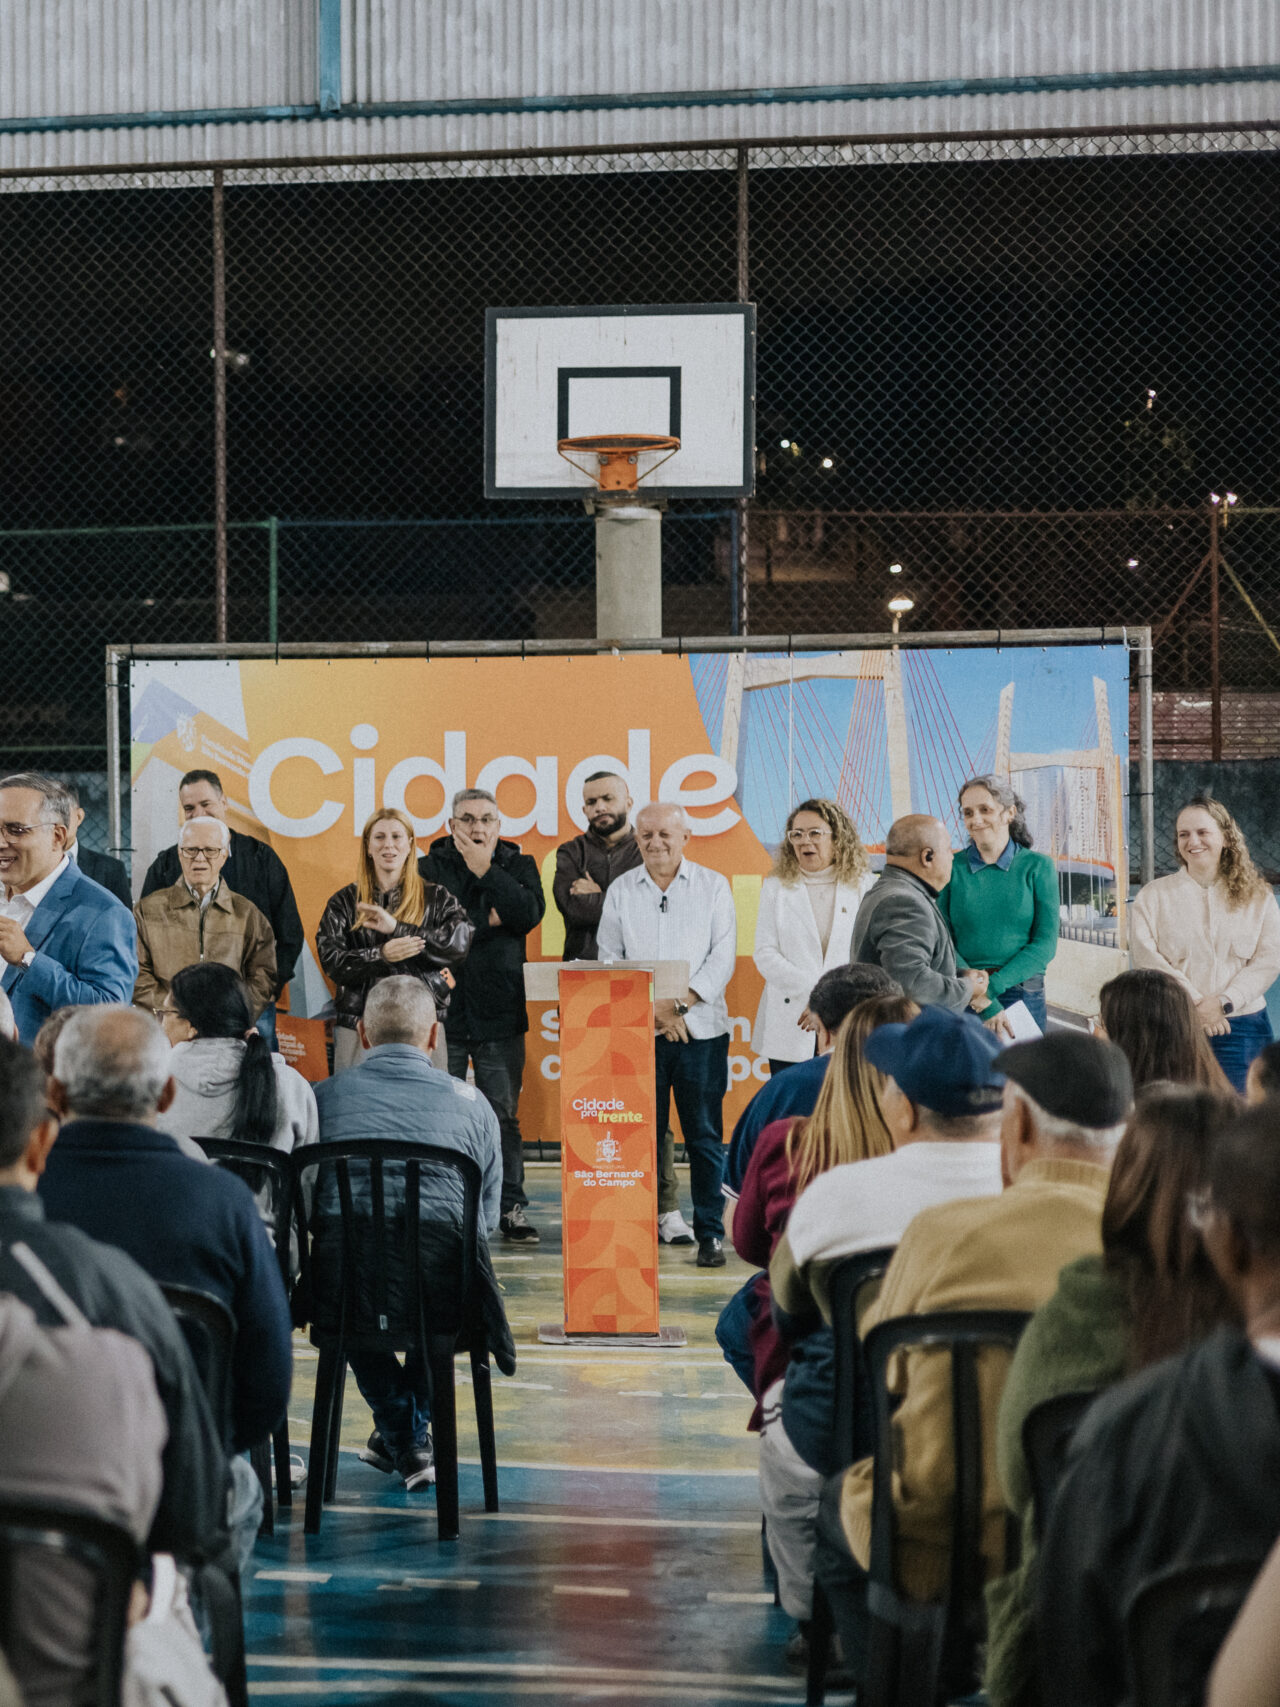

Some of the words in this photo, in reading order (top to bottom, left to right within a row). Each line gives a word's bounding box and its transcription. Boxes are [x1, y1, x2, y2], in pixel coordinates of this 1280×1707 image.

[248, 723, 741, 838] Cidade
[572, 1098, 625, 1111] Cidade
[581, 1110, 598, 1119] pra
[598, 1111, 643, 1123] frente
[574, 1170, 594, 1178] São
[596, 1170, 645, 1178] Bernardo
[583, 1179, 596, 1187] do
[598, 1179, 636, 1188] Campo
